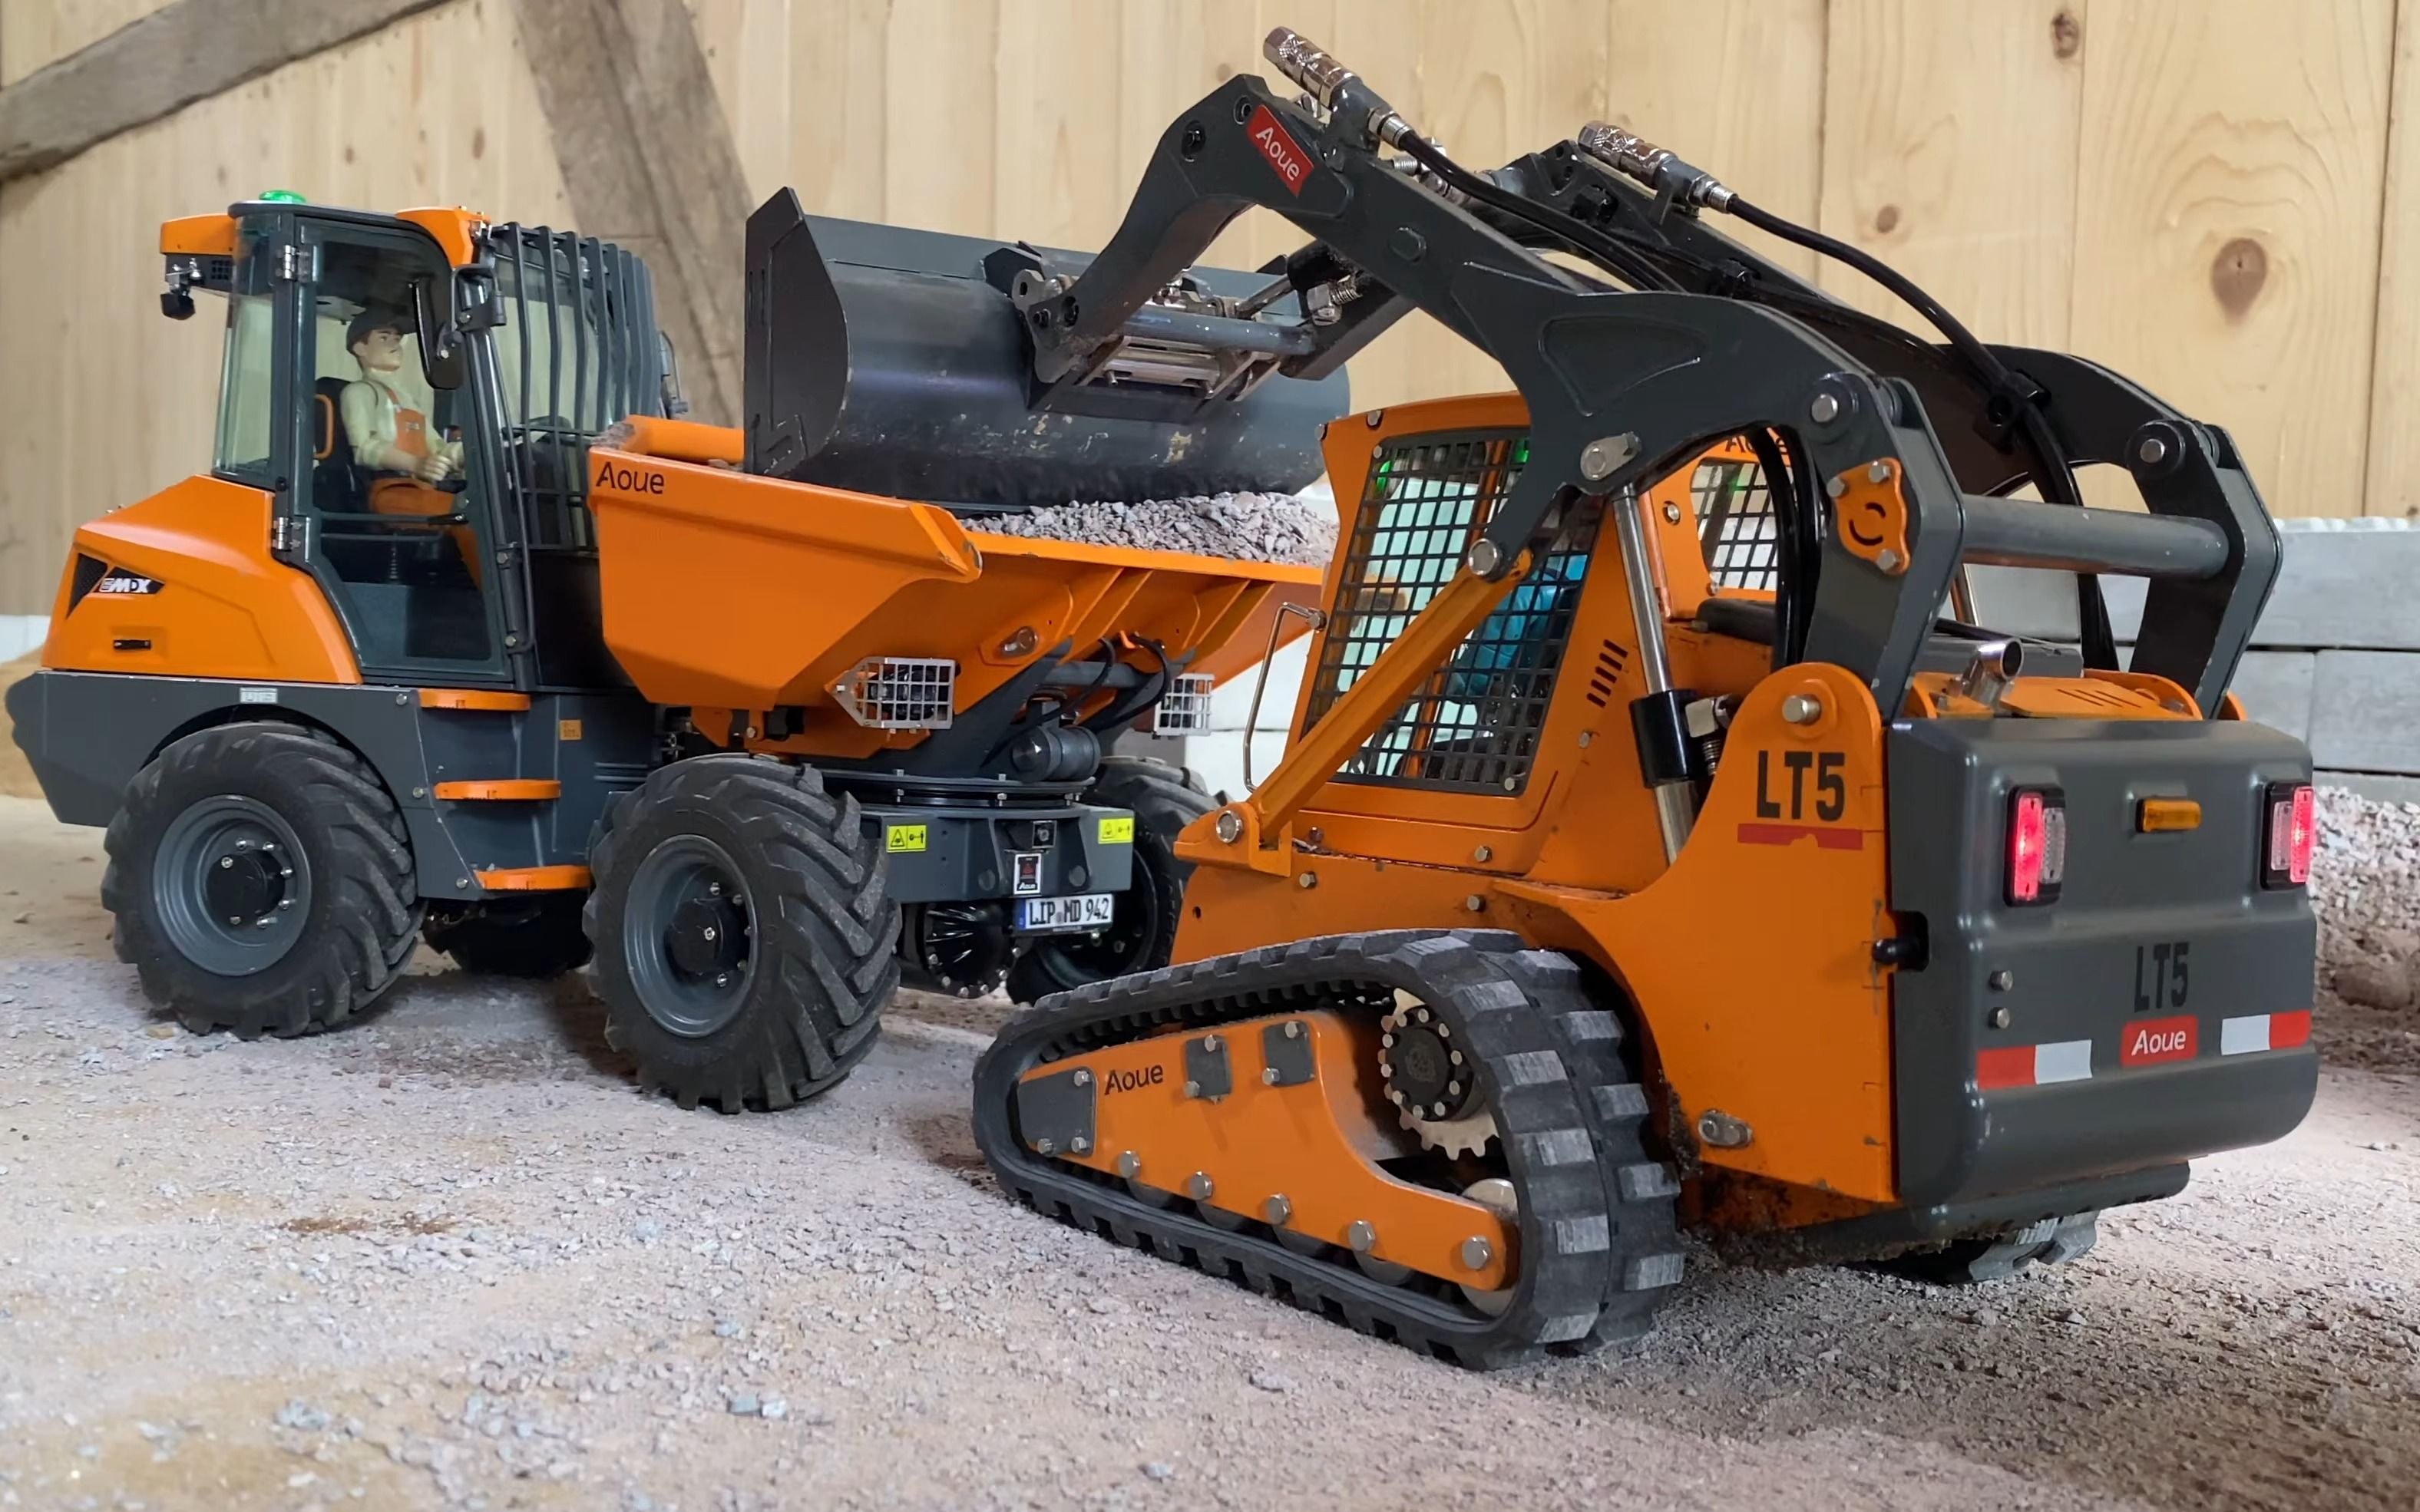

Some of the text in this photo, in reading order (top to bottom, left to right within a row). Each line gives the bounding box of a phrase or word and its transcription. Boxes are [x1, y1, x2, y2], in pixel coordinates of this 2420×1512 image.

[1255, 127, 1300, 181] Aoue
[596, 461, 664, 494] Aoue
[1757, 750, 1845, 822] LT5
[1030, 901, 1056, 926] LIP
[1086, 897, 1109, 921] 942
[2134, 942, 2189, 1013] LT5
[2131, 1029, 2187, 1056] Aoue
[1104, 1065, 1164, 1095] Aoue
